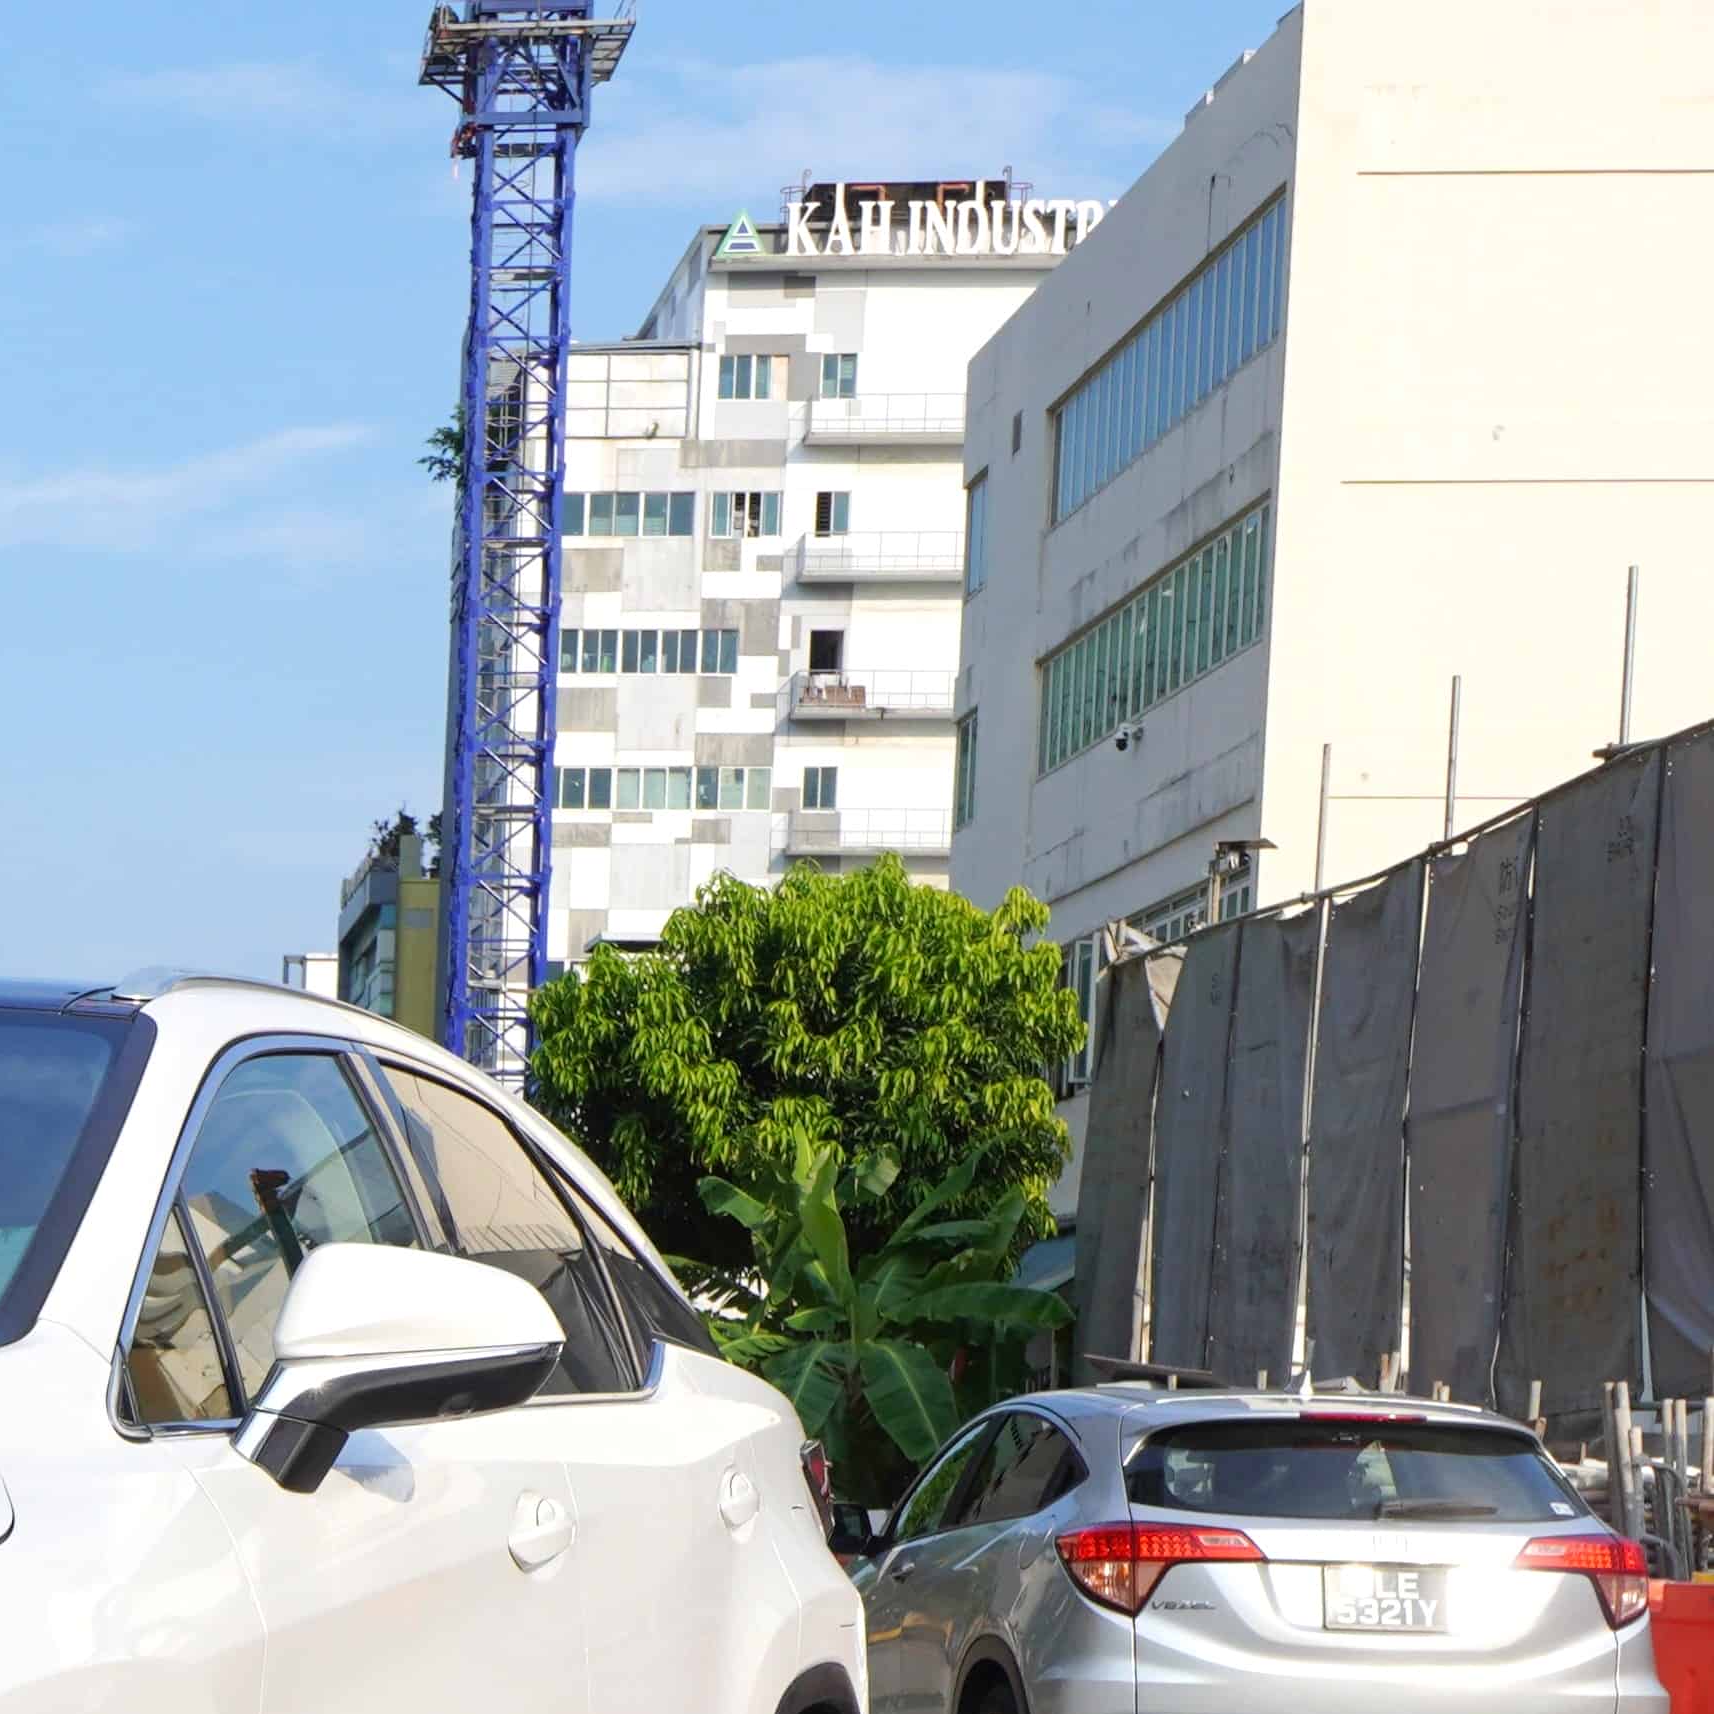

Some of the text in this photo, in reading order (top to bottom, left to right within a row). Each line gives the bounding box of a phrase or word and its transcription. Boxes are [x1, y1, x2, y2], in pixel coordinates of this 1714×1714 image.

[785, 199, 1119, 256] KAH INDUSTR
[1336, 1600, 1438, 1628] 5321Y
